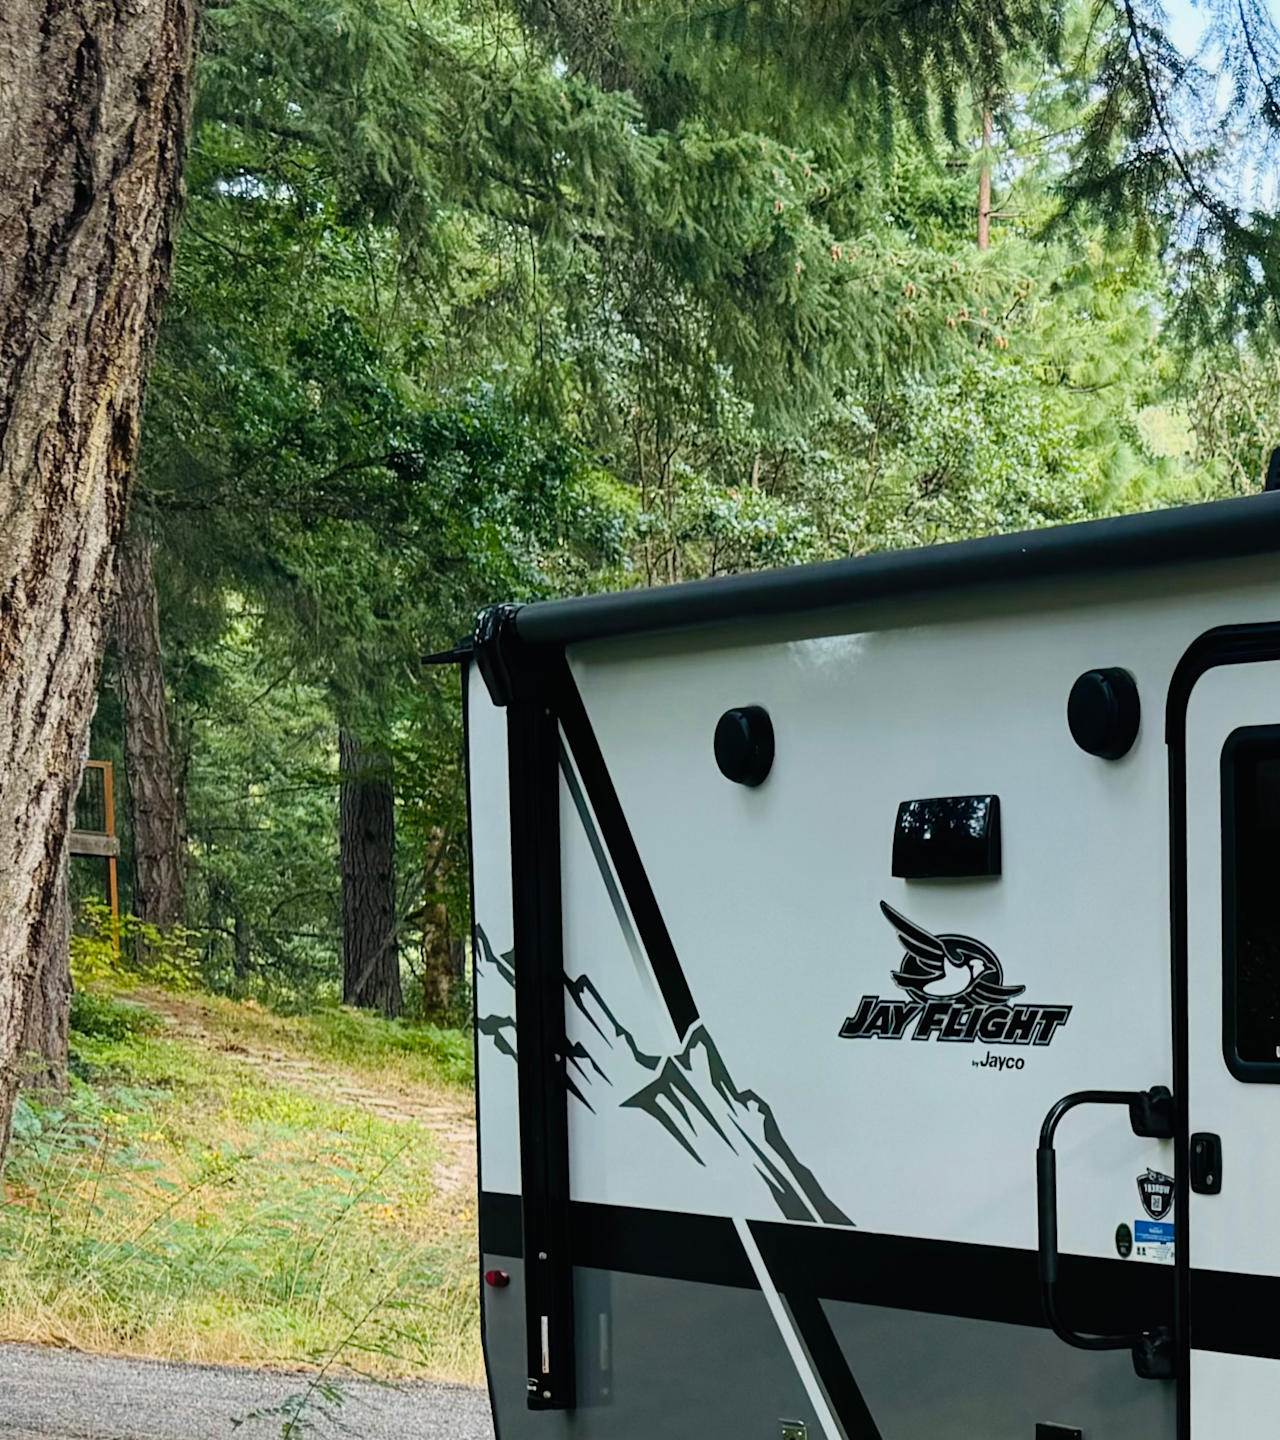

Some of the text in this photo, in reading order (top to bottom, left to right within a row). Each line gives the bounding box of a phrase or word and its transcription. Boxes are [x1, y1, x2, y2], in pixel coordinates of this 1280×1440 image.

[838, 996, 1073, 1046] JAY FLIGHT
[980, 1051, 1025, 1071] Jayco
